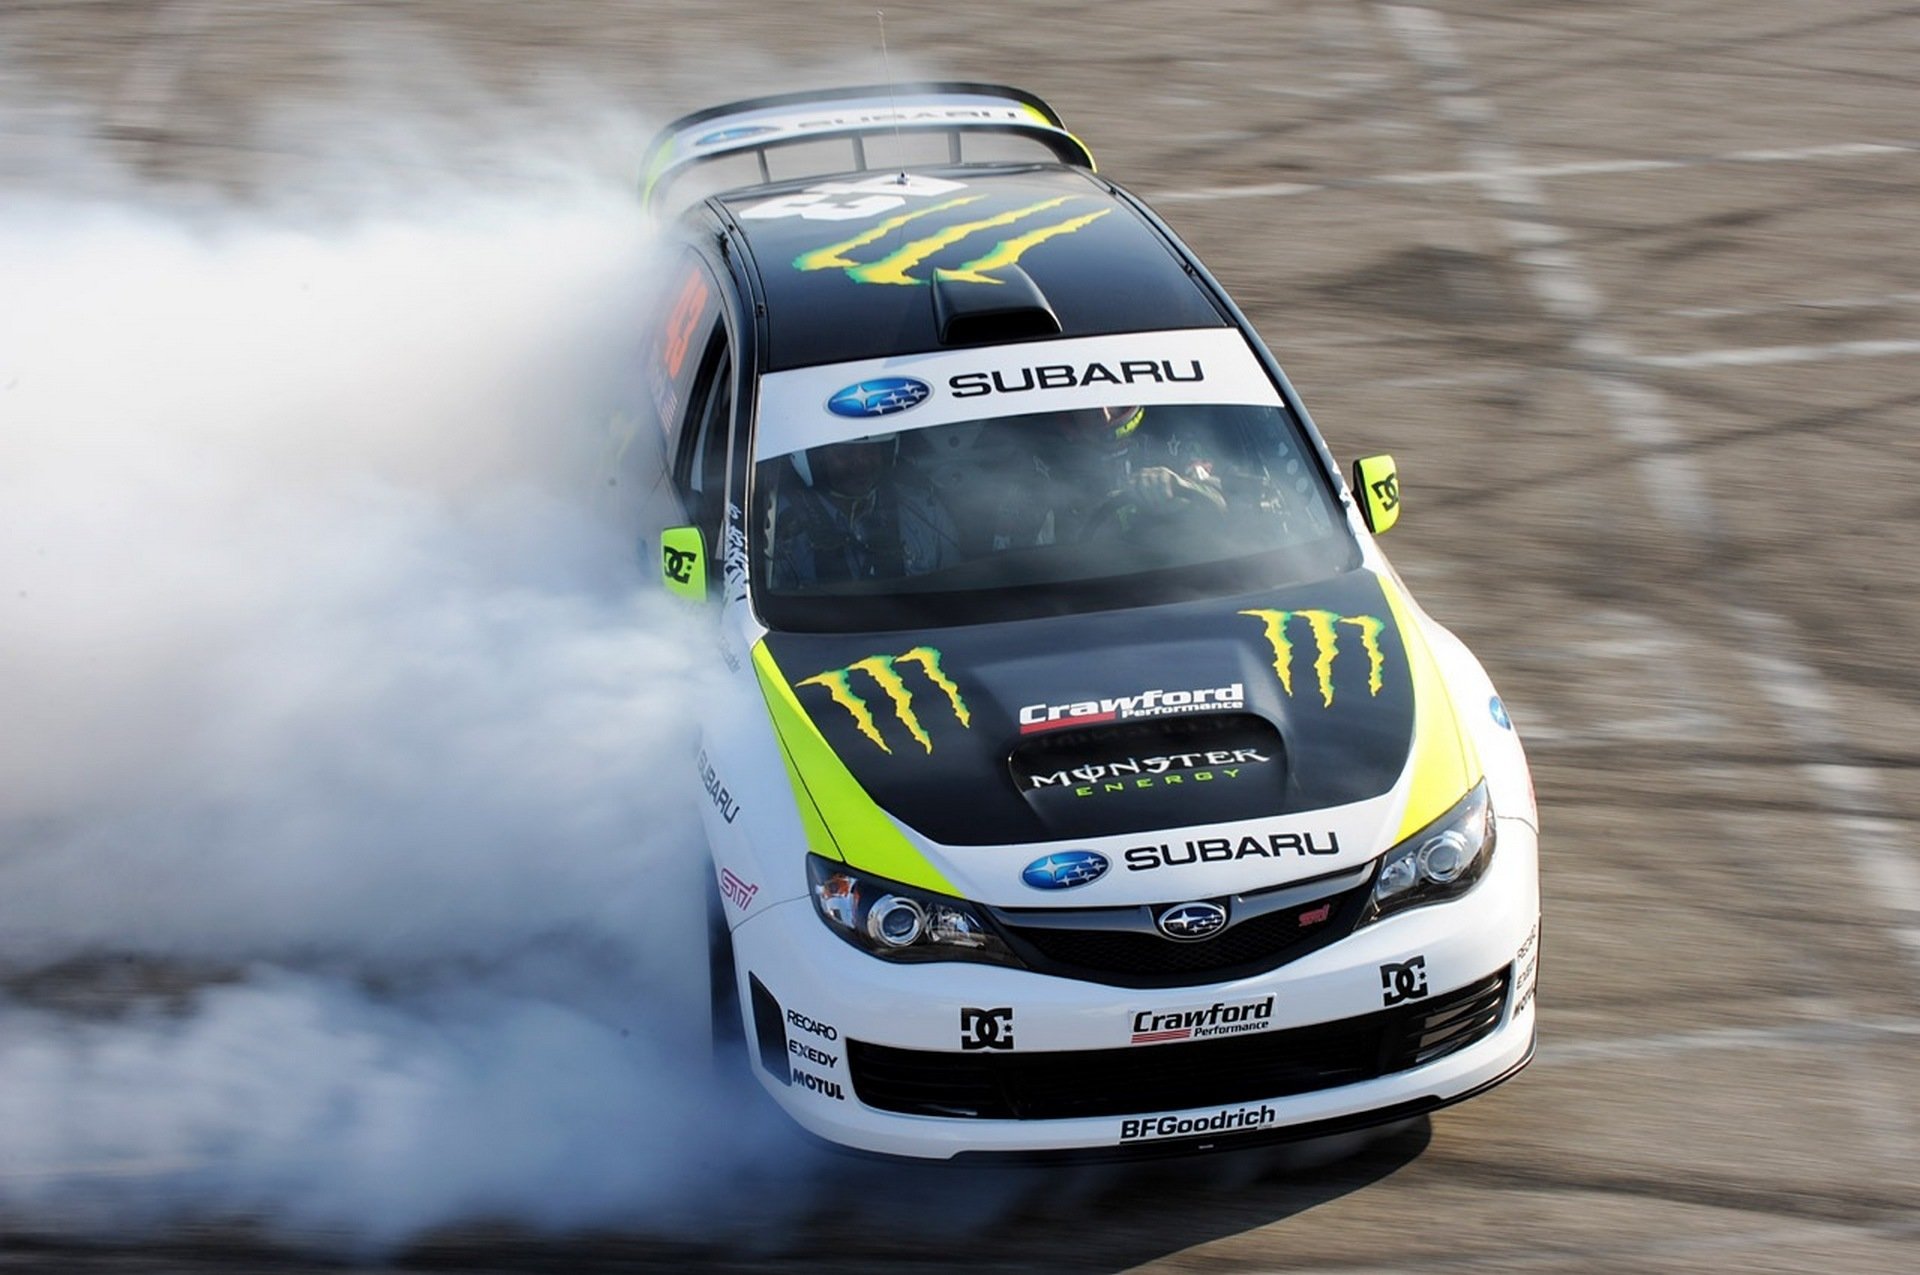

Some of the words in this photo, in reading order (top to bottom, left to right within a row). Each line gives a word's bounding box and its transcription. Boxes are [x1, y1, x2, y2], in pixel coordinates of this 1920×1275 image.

[948, 359, 1204, 398] SUBARU
[1020, 683, 1244, 725] Crawford
[1122, 700, 1244, 719] Performance
[1030, 748, 1271, 788] MONSTER
[1075, 768, 1240, 797] ENERGY
[698, 750, 740, 824] SUBARU
[1124, 832, 1340, 871] SUBARU
[787, 1009, 838, 1041] RECARO
[1133, 997, 1274, 1033] Crawford
[1194, 1020, 1269, 1037] Performance
[789, 1039, 838, 1068] EXEDY
[793, 1068, 844, 1101] MOTUL
[1120, 1105, 1275, 1139] BFGoodrich
